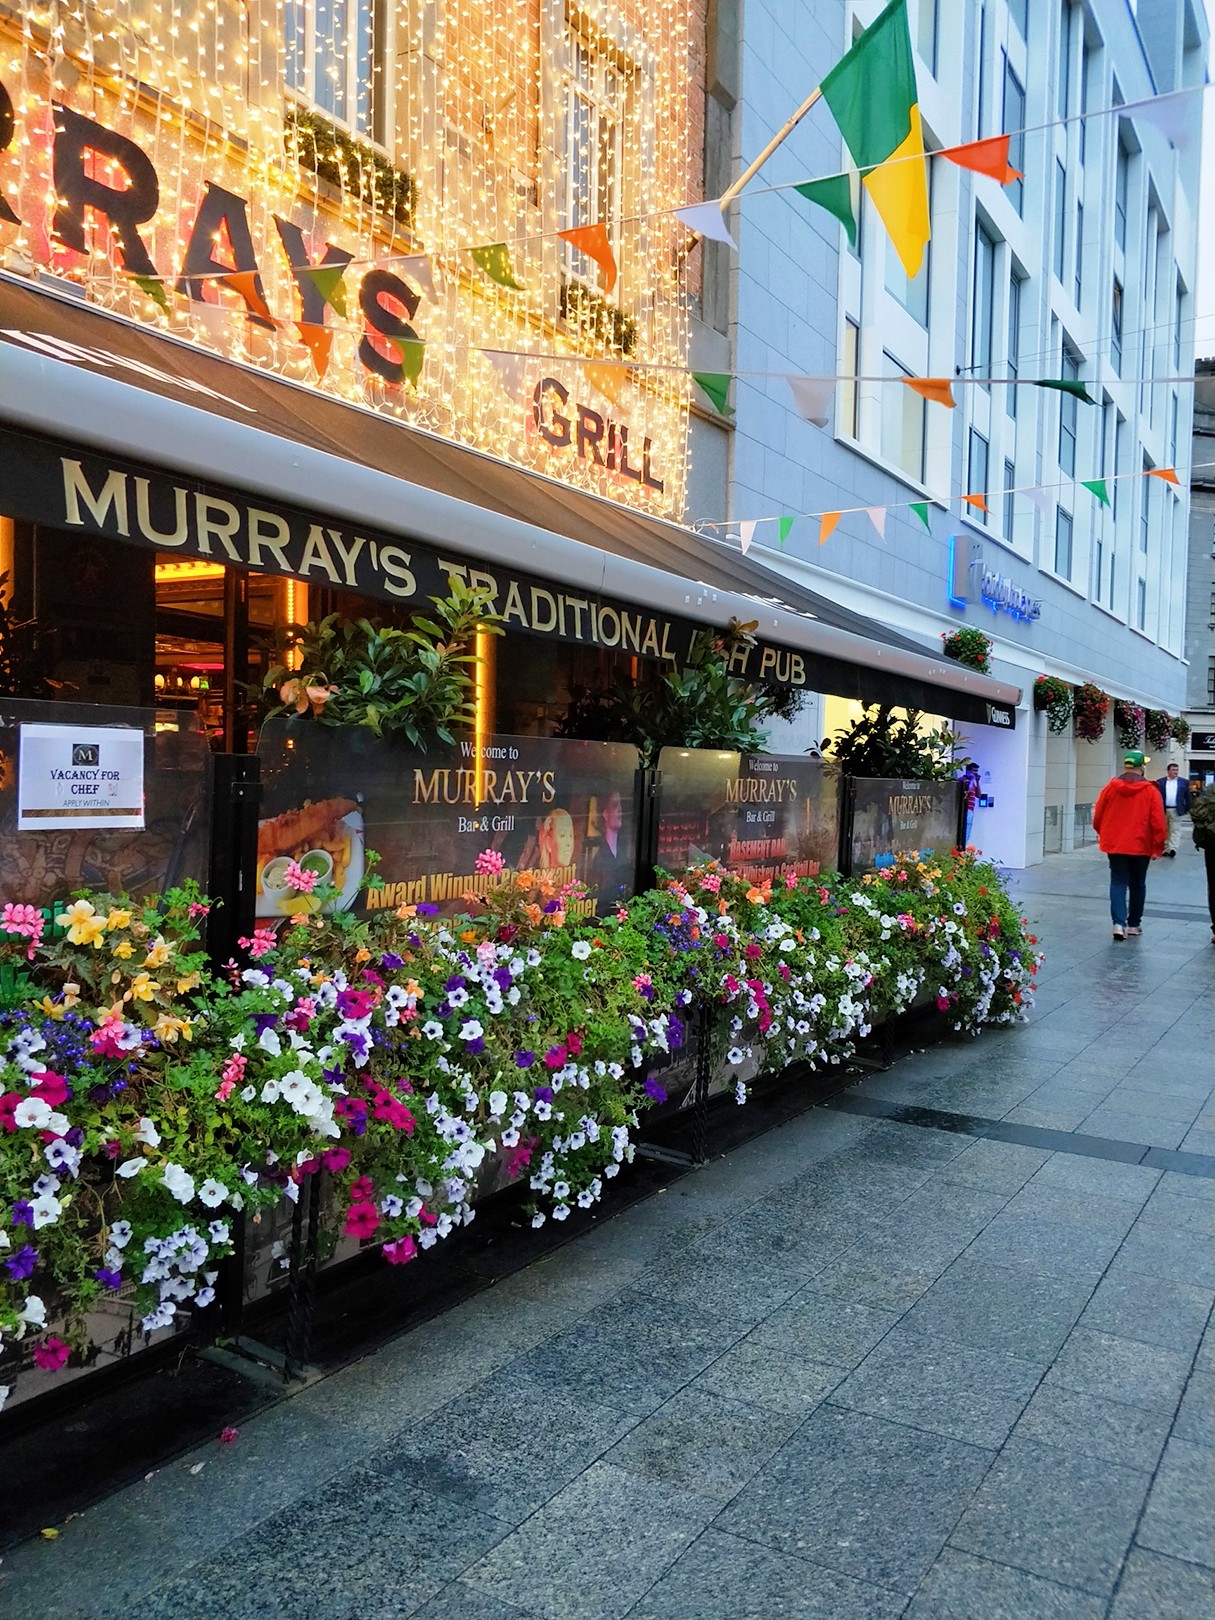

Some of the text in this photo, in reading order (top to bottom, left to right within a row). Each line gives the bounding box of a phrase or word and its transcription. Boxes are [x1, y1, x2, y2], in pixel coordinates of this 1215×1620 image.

[0, 80, 423, 384] RAYS
[533, 377, 664, 494] GRILL
[60, 457, 418, 598] MURRAY'S
[758, 647, 807, 685] PUB
[78, 750, 93, 761] M
[460, 741, 519, 760] Wecome to
[50, 769, 120, 780] VACANCY FOR
[773, 762, 779, 771] to
[71, 784, 100, 795] CHEF
[412, 767, 556, 804] MURRAY'S
[725, 778, 797, 803] MURRAY'S
[83, 799, 110, 807] WITHIN
[888, 796, 932, 815] MURRAY'S
[458, 815, 515, 833] Bar & Grill
[746, 810, 776, 823] Bar & Grill
[366, 873, 427, 911] Award
